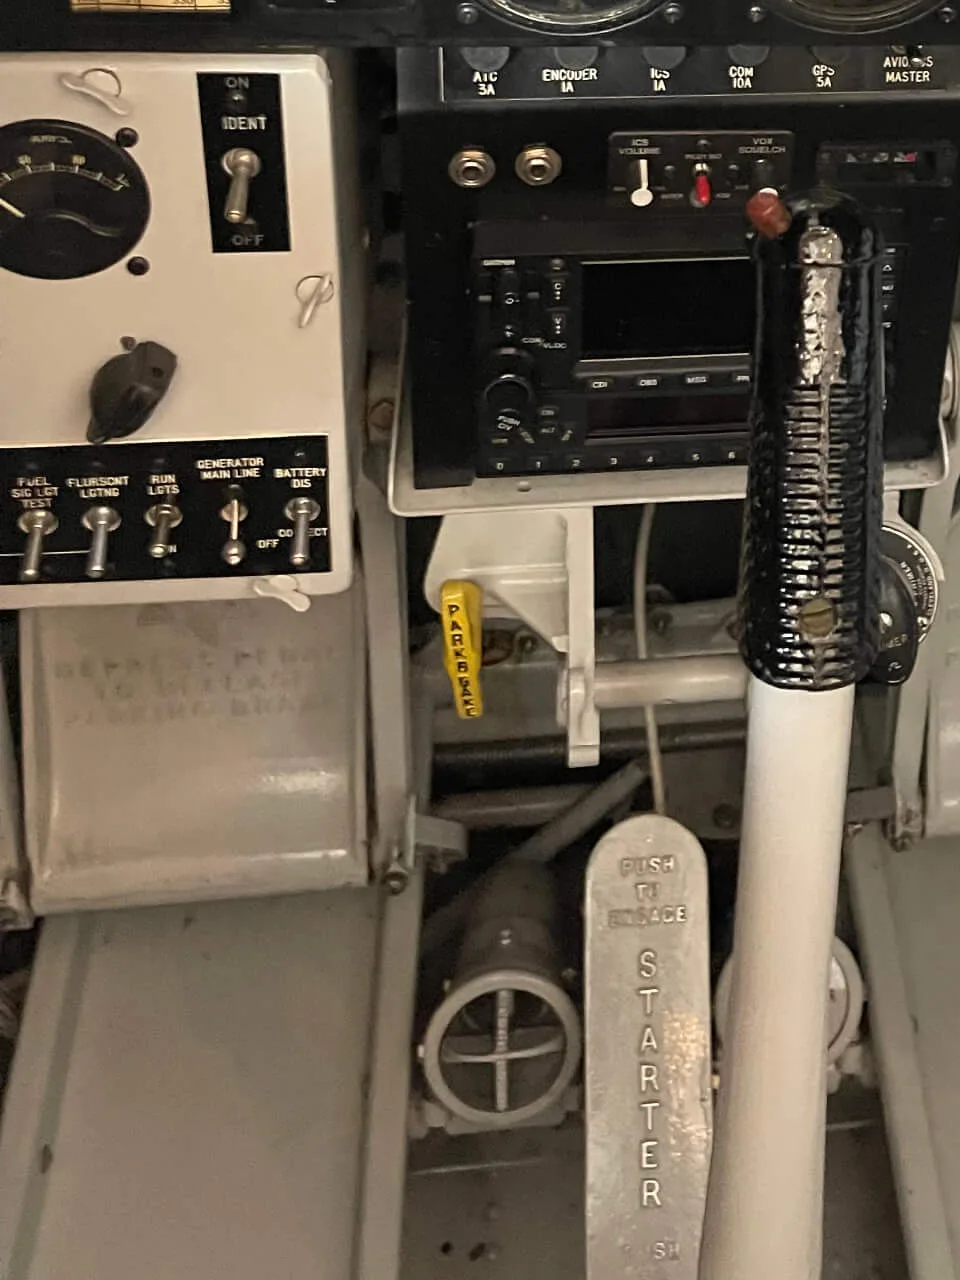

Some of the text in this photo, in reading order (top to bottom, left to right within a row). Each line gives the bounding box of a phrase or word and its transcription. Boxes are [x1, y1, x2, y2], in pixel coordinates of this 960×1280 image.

[883, 56, 933, 68] AVIOS
[542, 68, 598, 81] ENCODER
[729, 66, 753, 78] COM
[812, 65, 835, 76] GPS
[816, 77, 832, 87] 5A
[886, 71, 931, 82] MASTER
[225, 77, 249, 88] ON
[733, 77, 752, 88] 10A
[478, 84, 496, 96] 3A
[222, 117, 266, 130] IDENT
[232, 234, 264, 245] OFF
[197, 457, 264, 469] GENERATOR
[201, 468, 261, 479] MAIN LINE
[274, 468, 327, 478] BATTERY
[17, 477, 50, 486] FUEL
[66, 476, 129, 487] FLURSCNT
[151, 474, 176, 484] RUN
[291, 479, 312, 488] DIS
[258, 539, 280, 548] OFF
[448, 604, 468, 659] PARK
[638, 949, 662, 1208] STARTER
